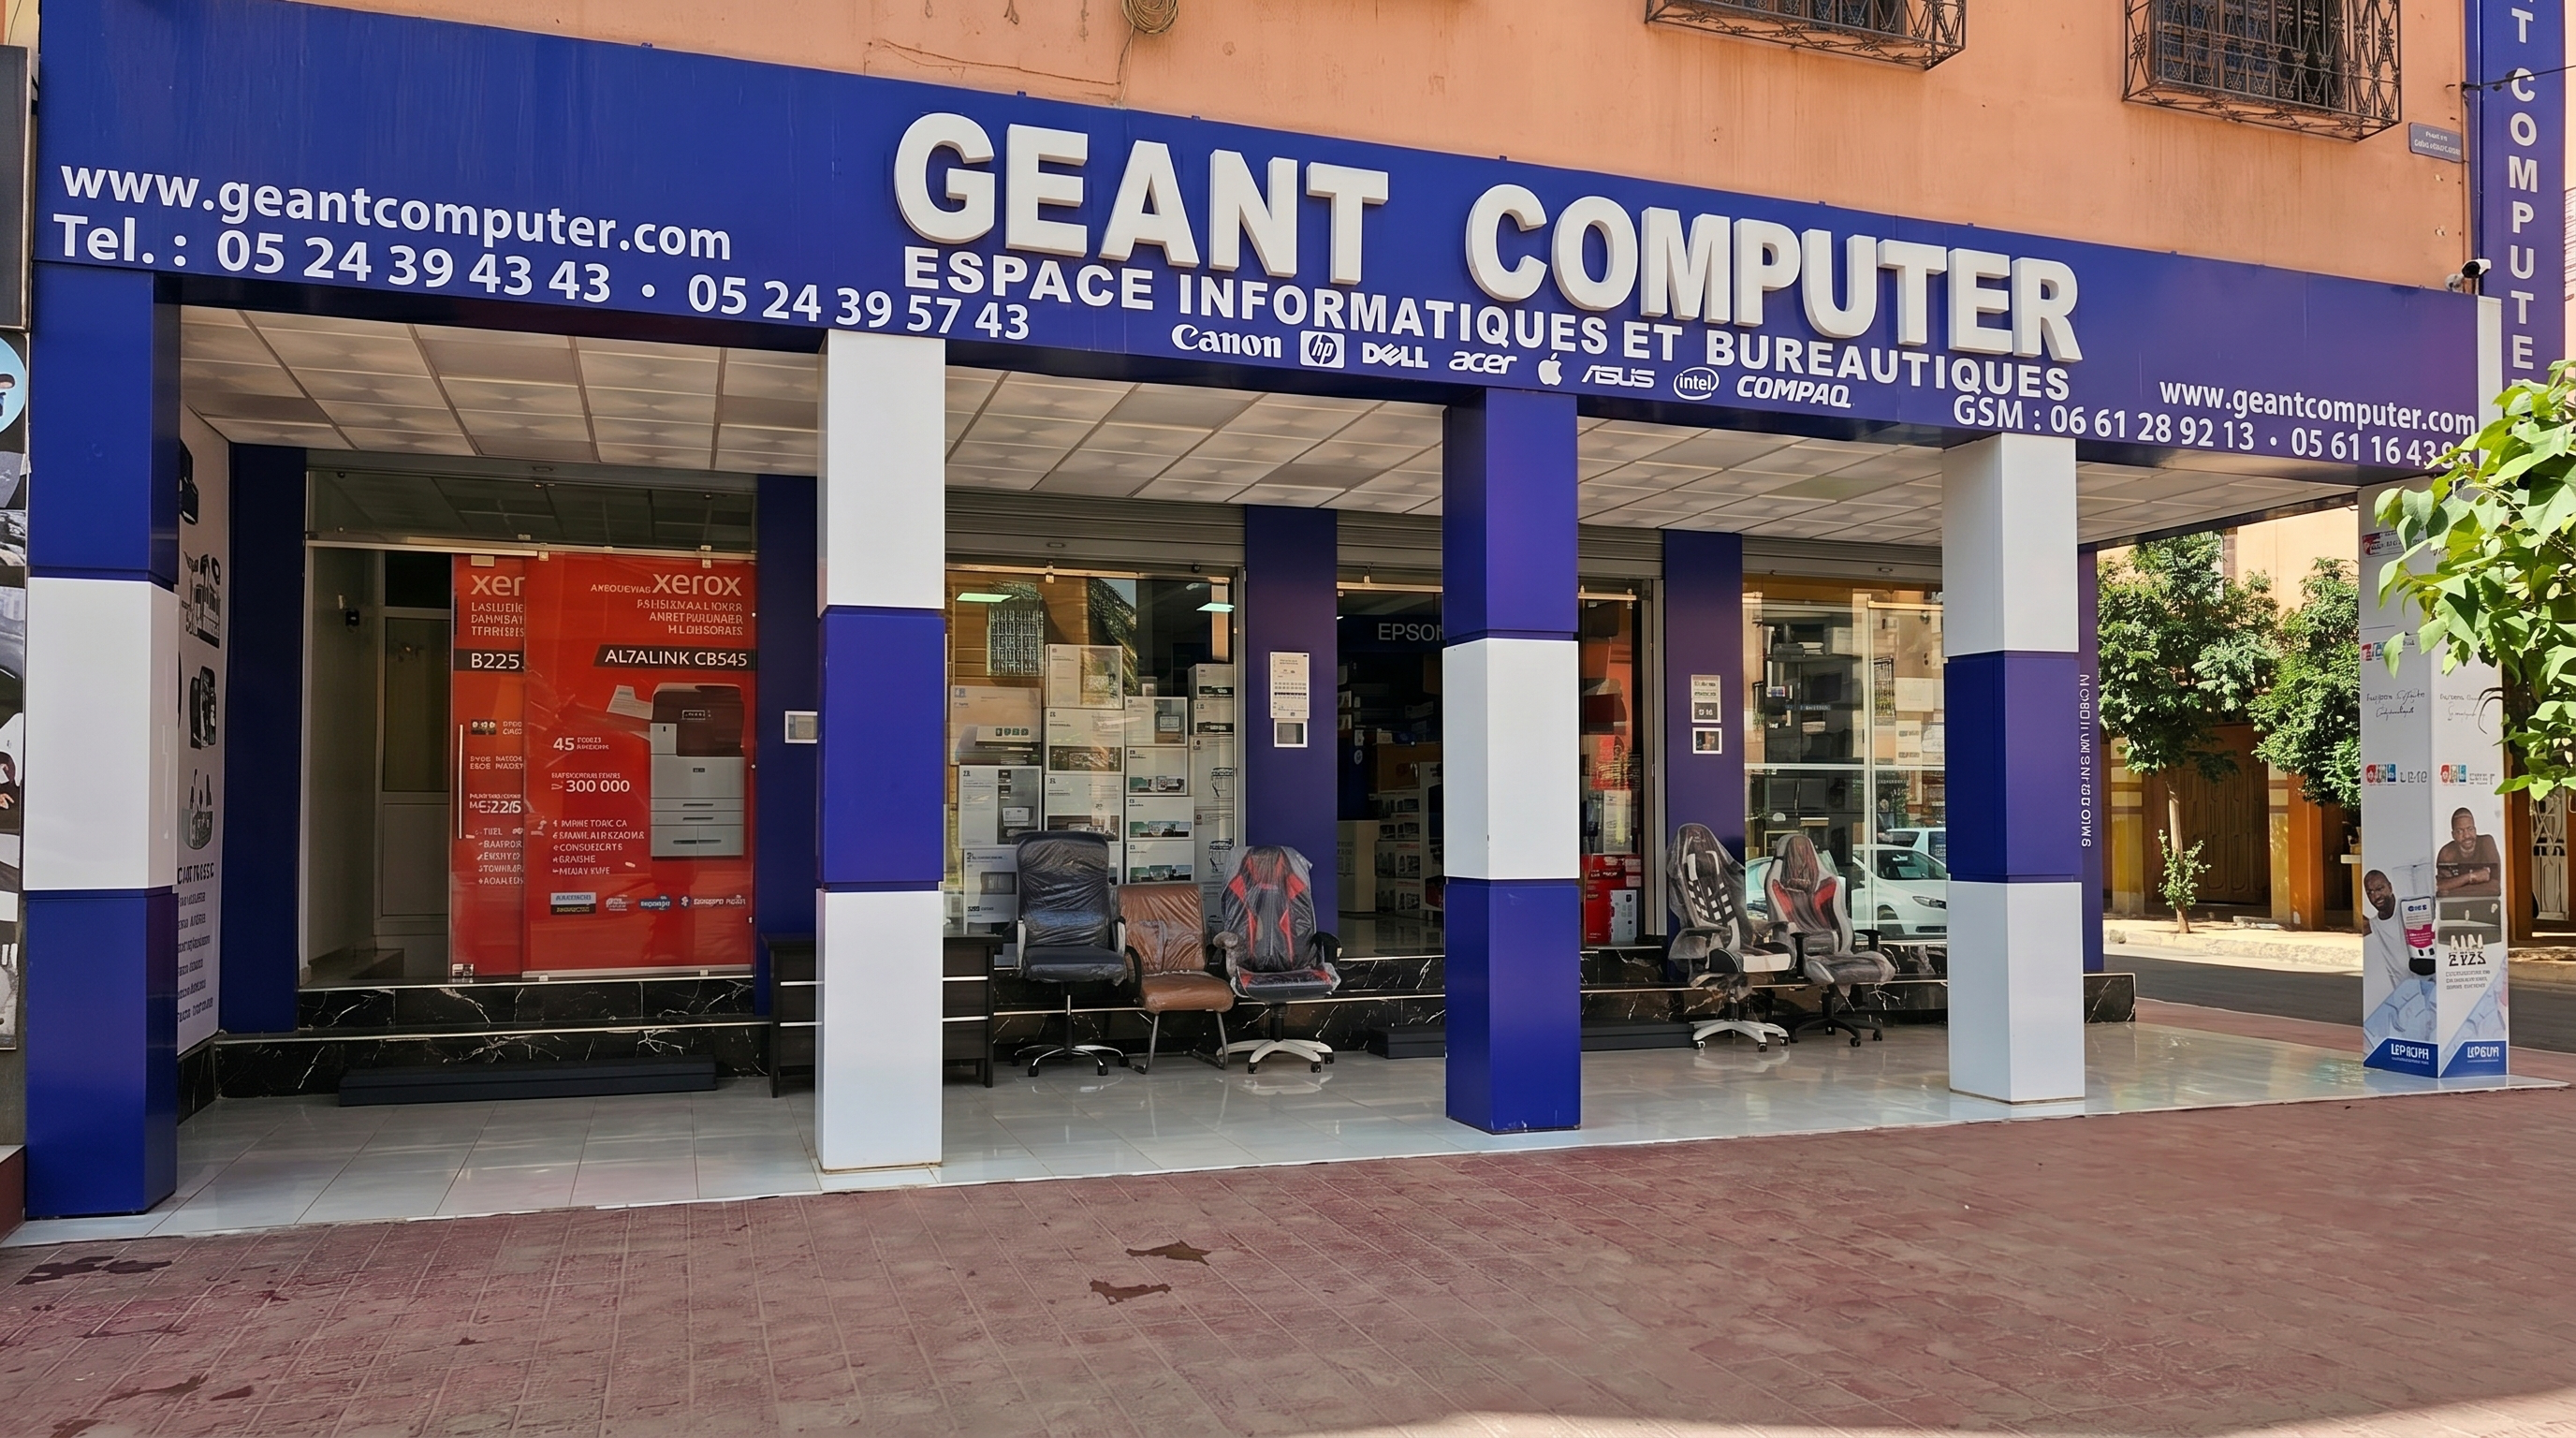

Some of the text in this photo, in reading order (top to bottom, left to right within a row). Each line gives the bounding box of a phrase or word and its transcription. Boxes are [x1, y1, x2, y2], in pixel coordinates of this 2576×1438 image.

[60, 165, 732, 262] www.geantcomputer.com
[894, 111, 2084, 363] GEANT COMPUTER
[2508, 67, 2538, 388] COMPUTE
[53, 213, 154, 265] Tel.
[217, 229, 285, 274] 05
[303, 236, 373, 283] 24
[388, 244, 454, 289] 39
[469, 253, 533, 297] 43
[549, 260, 611, 304] 43
[688, 273, 748, 315] 05
[762, 280, 822, 322] 24
[827, 286, 892, 329] 39
[906, 294, 962, 334] 57
[974, 301, 1029, 341] 43
[904, 244, 2071, 403] ESPACE INFORMATIQUES ET BUREAUTIQUES
[1171, 323, 1282, 359] Canon
[1361, 342, 1430, 369] DELL
[1448, 350, 1518, 374] acer
[1581, 364, 1655, 389] ASUS
[1678, 373, 1713, 392] intel
[1736, 374, 1852, 410] COMPAQ
[1954, 394, 2024, 432] GSM
[2050, 404, 2088, 435] 06
[2094, 408, 2127, 439] 61
[2137, 412, 2173, 444] 28
[2179, 416, 2216, 448] 92
[2223, 419, 2256, 450] 13
[2291, 427, 2324, 459] 05
[2331, 431, 2361, 462] 61
[2371, 435, 2402, 465] 16
[2406, 439, 2437, 469] 43
[2159, 381, 2478, 438] www.geantcomputer.com
[651, 573, 742, 597] xerox
[694, 652, 748, 667] CB545
[552, 737, 575, 751] 45
[565, 779, 631, 793] 300 000
